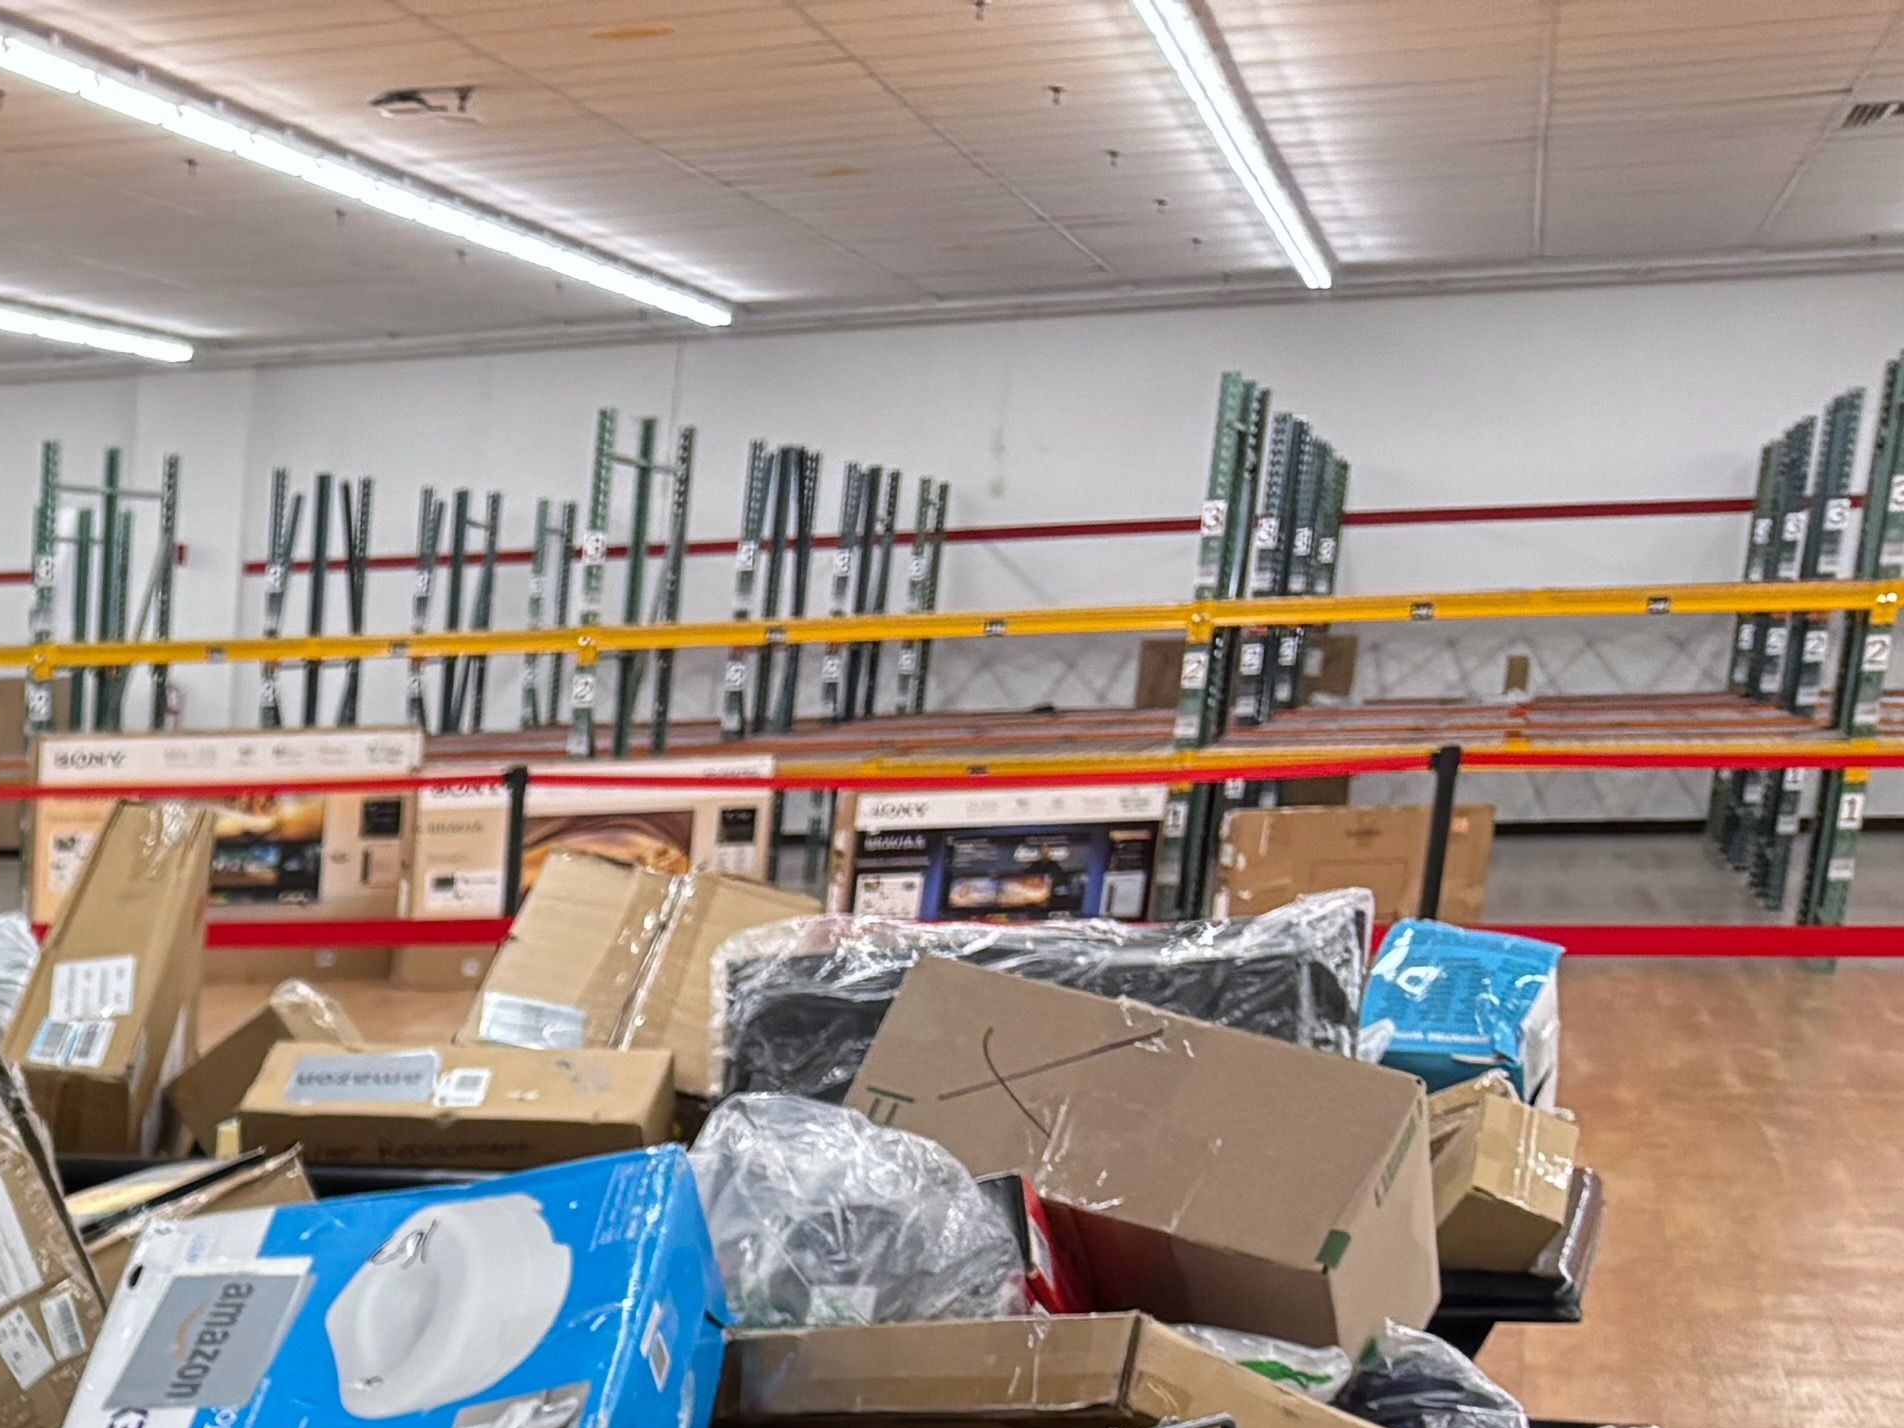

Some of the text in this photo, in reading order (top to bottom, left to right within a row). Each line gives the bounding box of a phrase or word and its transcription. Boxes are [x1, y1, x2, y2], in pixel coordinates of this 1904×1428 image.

[1204, 503, 1219, 527] 3
[1808, 635, 1823, 656] 2
[1869, 640, 1888, 665] 2
[1184, 657, 1202, 680] 2
[165, 1281, 255, 1400] amazon
